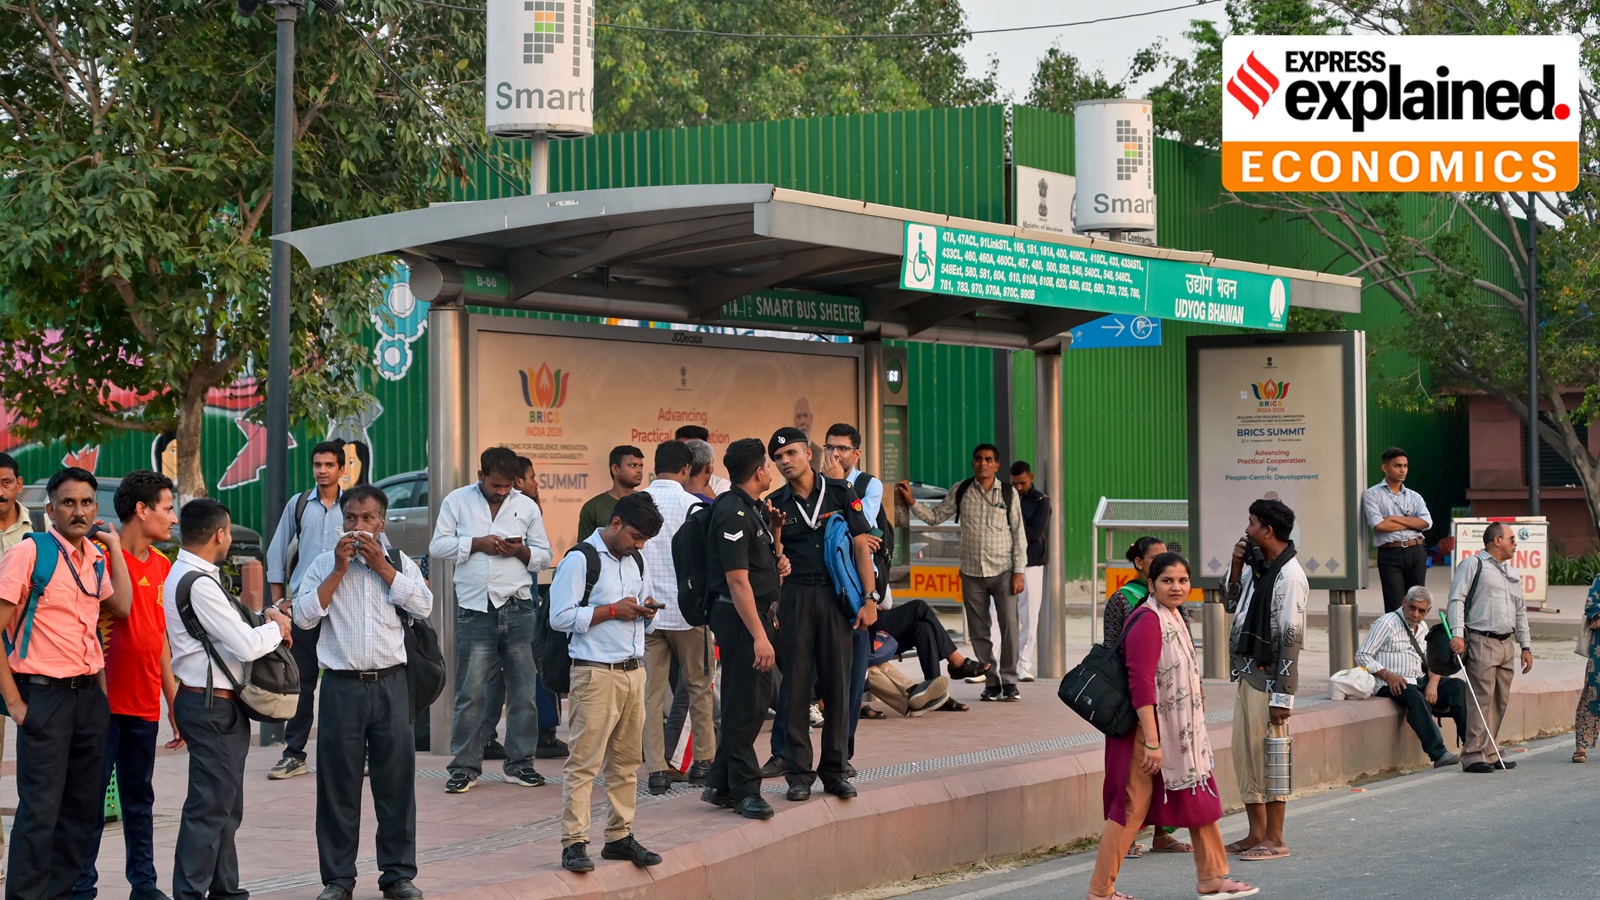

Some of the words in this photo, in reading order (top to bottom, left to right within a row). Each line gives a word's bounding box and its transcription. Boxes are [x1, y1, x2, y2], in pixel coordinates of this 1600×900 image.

[495, 81, 586, 113] Smart
[942, 231, 956, 245] 47A,
[957, 233, 979, 248] 47ACL,
[1027, 243, 1039, 256] 181,
[1040, 246, 1056, 259] 181A,
[1056, 248, 1069, 261] 400,
[1090, 253, 1108, 266] 410CL,
[1109, 256, 1120, 268] 433,
[942, 247, 963, 262] 433CL,
[1046, 261, 1058, 274] 500,
[1059, 263, 1071, 276] 520,
[1072, 265, 1083, 277] 540,
[476, 275, 497, 288] B-66
[1009, 272, 1021, 285] 610,
[1022, 273, 1038, 287] 610A,
[1055, 278, 1068, 290] 620,
[1185, 267, 1214, 297] उद्योग
[1217, 277, 1238, 300] भवन
[971, 283, 984, 296] 970,
[985, 284, 1002, 298] 970A,
[756, 296, 794, 318] SMART
[797, 300, 817, 320] BUS
[819, 302, 861, 323] SHELTER
[1174, 298, 1206, 320] UDYOG
[1207, 302, 1245, 325] BHAWAN
[671, 331, 704, 344] JCDecaux
[529, 410, 560, 424] BRICS
[657, 407, 708, 425] Advancing
[526, 426, 546, 437] INDIA
[547, 426, 563, 437] 2026
[631, 428, 672, 443] Practical
[1237, 428, 1265, 437] BRICS
[1267, 427, 1306, 437] SUMMIT
[1254, 449, 1290, 457] Advancing
[1266, 457, 1306, 465] Cooperation
[539, 473, 589, 490] SUMMIT
